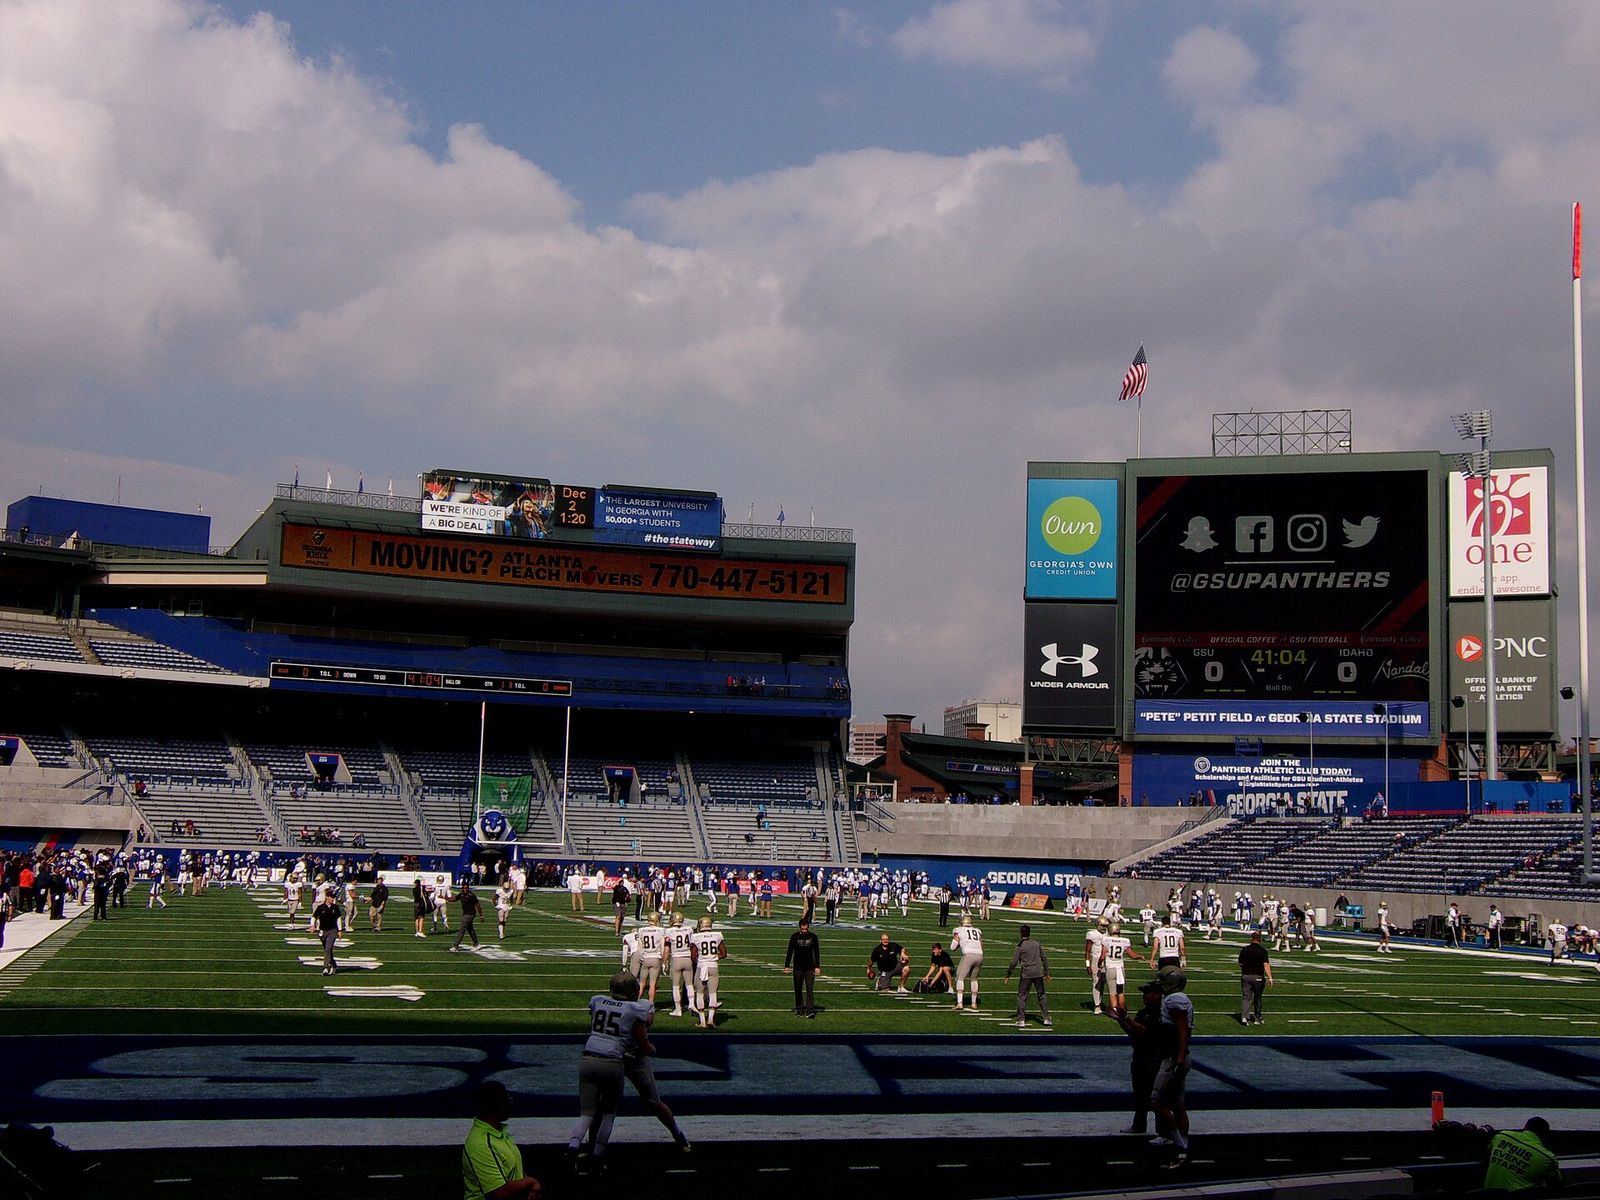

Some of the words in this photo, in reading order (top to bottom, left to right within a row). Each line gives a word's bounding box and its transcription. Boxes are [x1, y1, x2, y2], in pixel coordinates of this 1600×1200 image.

[562, 487, 587, 499] Dec
[430, 503, 462, 515] WE'RE
[462, 507, 487, 516] KIND
[488, 509, 502, 517] OF
[569, 501, 577, 511] 2
[624, 498, 660, 507] LARGEST
[662, 501, 708, 511] UNIVERSITY
[606, 506, 614, 514] IN
[614, 507, 650, 516] GEORGIA
[651, 509, 673, 517] WITH
[428, 518, 436, 527] A
[438, 519, 455, 528] BIG
[456, 520, 484, 531] DEAL
[559, 512, 587, 525] 1:20
[605, 515, 638, 525] 50,000+
[638, 517, 681, 528] STUDENTS
[1045, 514, 1097, 535] Own
[644, 533, 716, 548] #thestateway
[371, 541, 493, 575] MOVING?
[1466, 542, 1532, 565] one
[502, 552, 582, 569] ATLANTA
[1029, 560, 1085, 568] GEORGIA'S
[1089, 560, 1114, 568] OWN
[499, 565, 560, 582] PEACH
[649, 563, 832, 596] 770-447-5121
[1500, 574, 1520, 583] app.
[1171, 571, 1392, 593] @GSUPANTHERS
[1457, 586, 1484, 595] endle
[1496, 585, 1544, 594] awesome.
[1308, 635, 1350, 643] FOOTBALL
[1193, 648, 1214, 657] GSU
[1251, 649, 1307, 665] 41:04
[1339, 648, 1374, 657] IDAHO
[1204, 660, 1224, 682] 0
[1337, 661, 1358, 683] 0
[408, 673, 441, 686] 41:04
[1065, 682, 1110, 690] ARMOUR
[1502, 676, 1525, 684] BANK
[1266, 683, 1280, 691] Ball
[1183, 712, 1217, 722] PETIT
[1219, 713, 1253, 722] FIELD
[1324, 713, 1363, 724] STATE
[1365, 714, 1422, 724] STADIUM
[1260, 759, 1282, 767] JOIN
[1283, 759, 1300, 767] THE
[1211, 766, 1252, 774] PANTHER
[1253, 766, 1294, 775] ATHLETIC
[1295, 767, 1319, 775] CLUB
[988, 871, 1051, 886] GEORGIA
[676, 934, 690, 948] 84
[967, 929, 979, 941] 19
[1164, 935, 1175, 948] 10
[643, 935, 656, 949] 81
[701, 941, 718, 955] 86
[1110, 945, 1122, 959] 12
[593, 1009, 622, 1036] 85
[1497, 1139, 1533, 1161] argus
[1490, 1156, 1528, 1176] STAFF
[1493, 1149, 1530, 1170] EVENT
